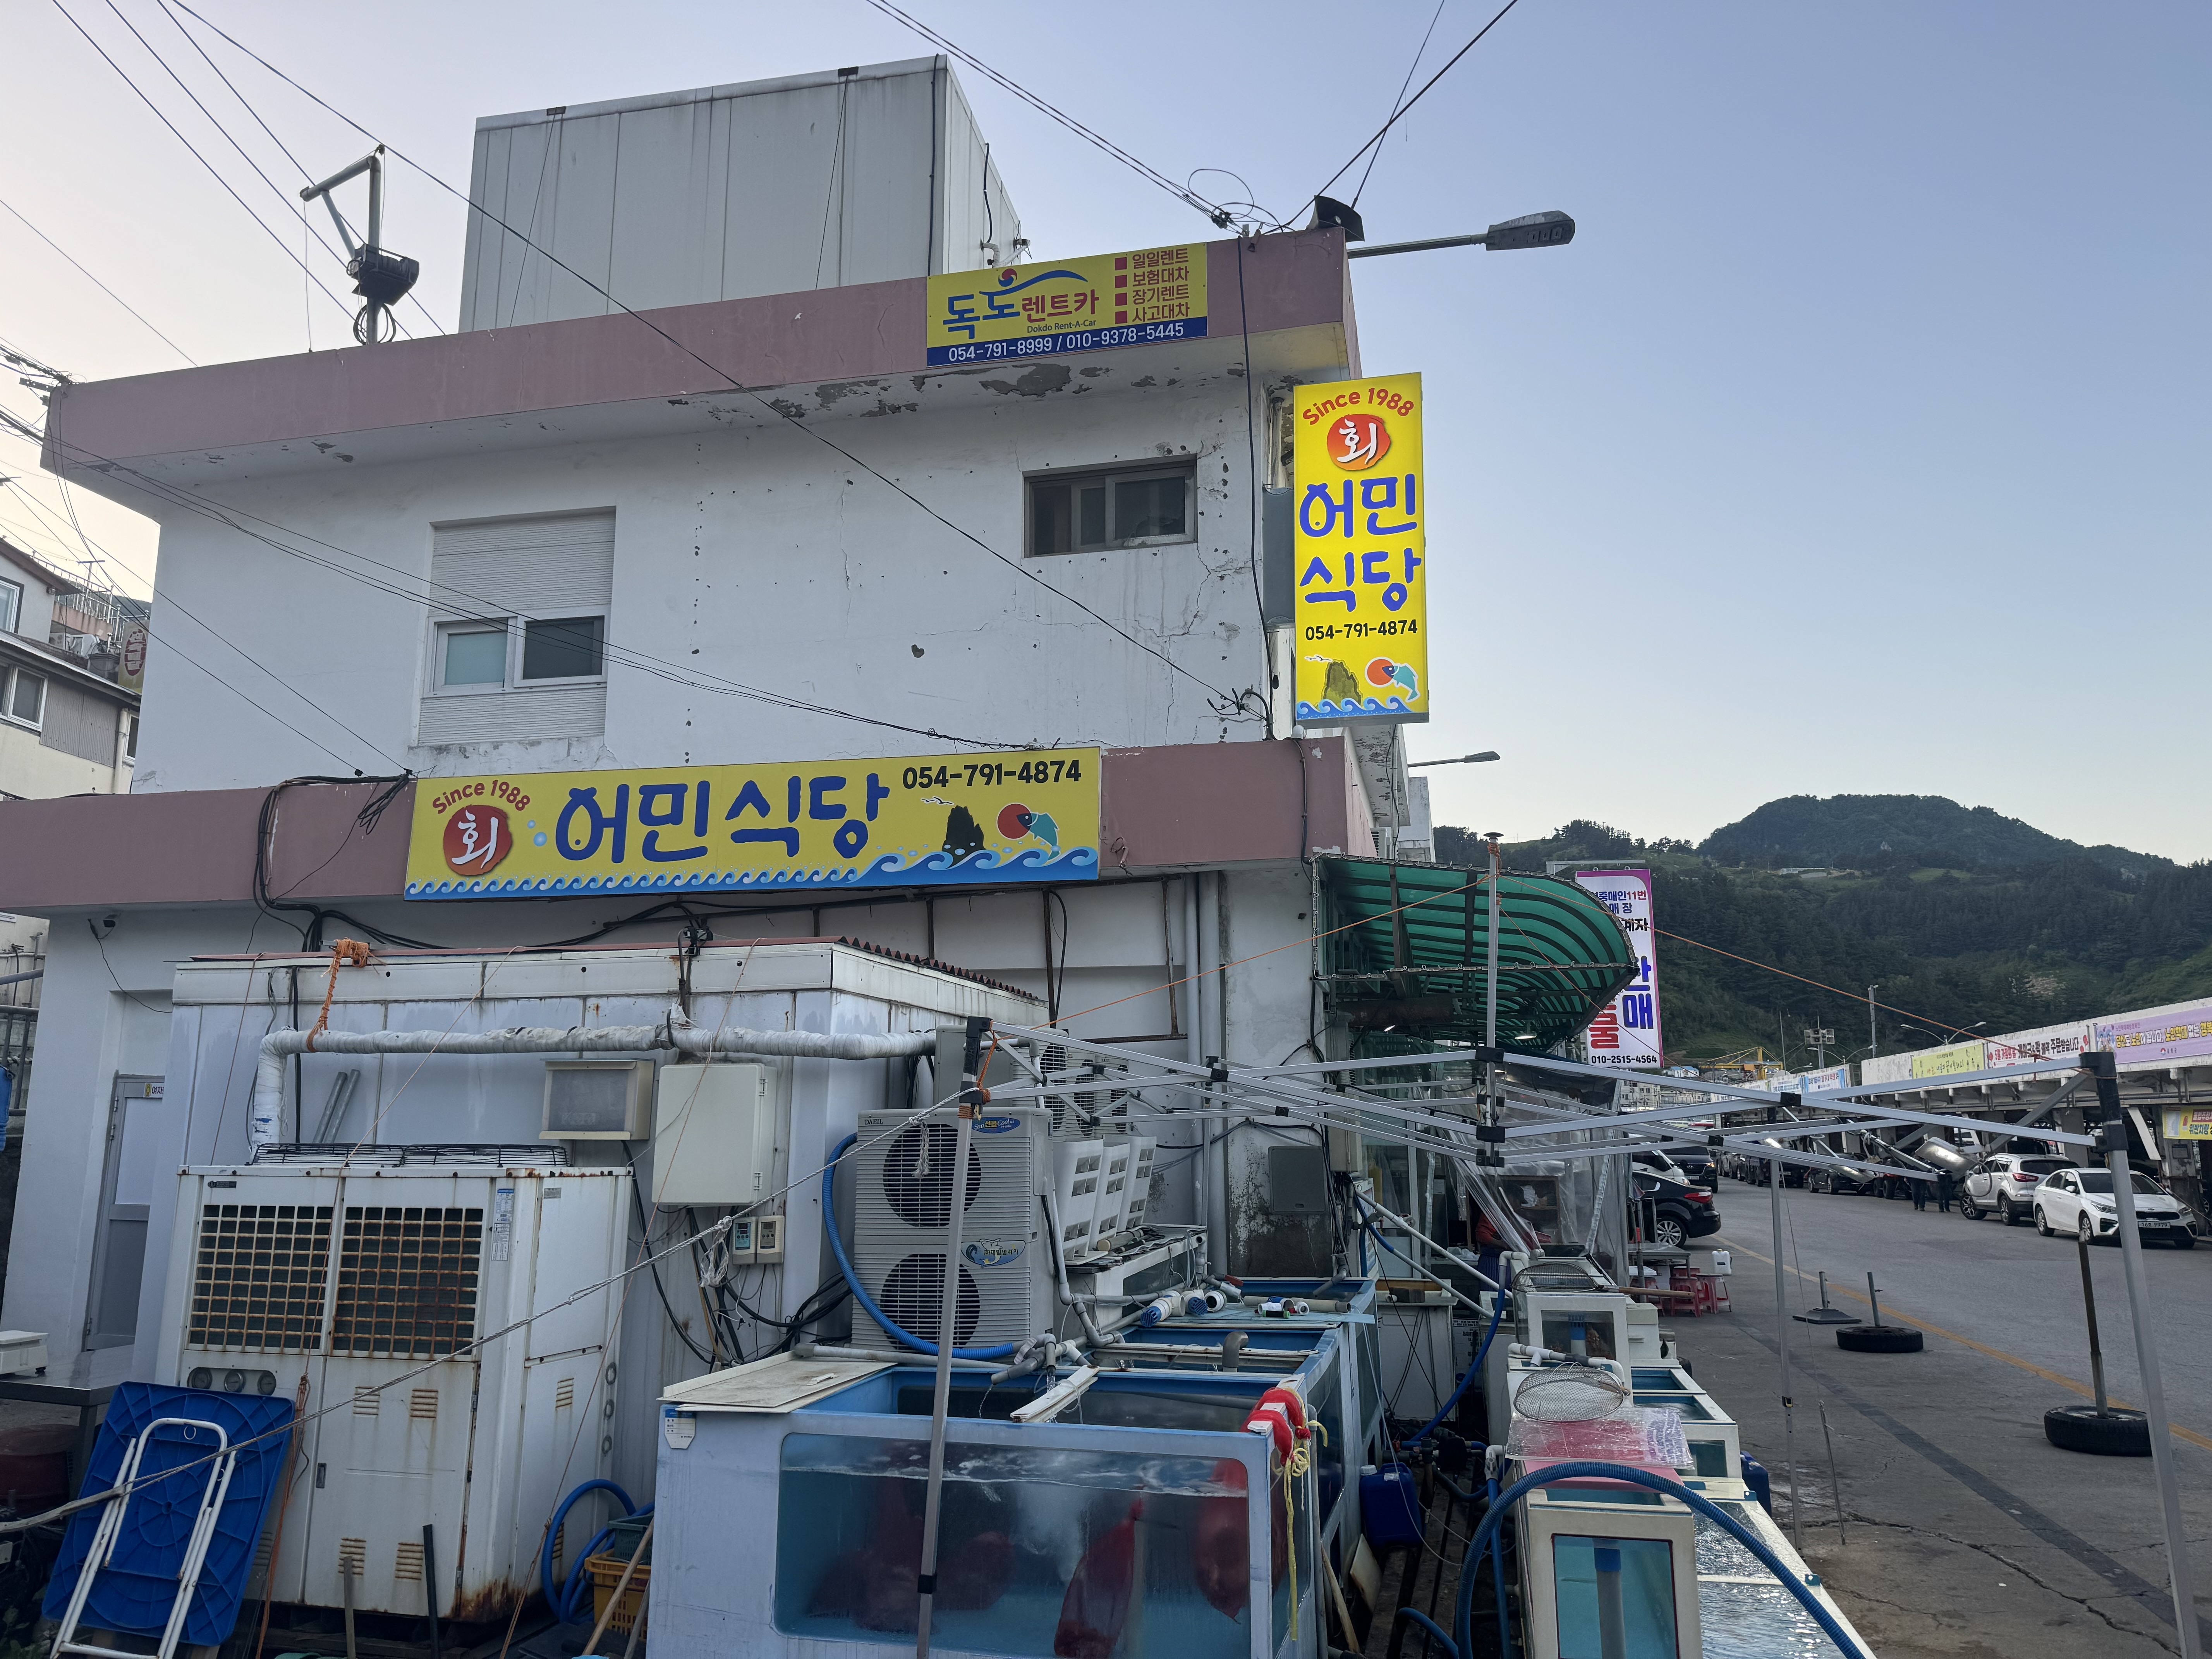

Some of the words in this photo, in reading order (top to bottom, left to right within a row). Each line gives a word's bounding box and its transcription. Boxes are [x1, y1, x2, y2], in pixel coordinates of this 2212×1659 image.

[1132, 248, 1189, 268] 일일렌트
[1133, 267, 1190, 287] 보험대차
[1133, 285, 1189, 304] 장기렌트
[1027, 324, 1053, 333] Dokdo
[1054, 319, 1096, 330] Rent-A-Car
[1132, 303, 1190, 323] 사고대차
[949, 339, 1053, 361] 054-791-8999
[1066, 322, 1184, 349] 010-9378-5445
[1303, 391, 1361, 425] Since
[1368, 388, 1414, 417] 1988
[1337, 420, 1378, 464] 회
[1300, 473, 1417, 538] 어민
[1300, 547, 1422, 612] 식당
[1305, 620, 1418, 641] 054-791-4874
[902, 759, 1081, 789] 054-791-4874
[433, 783, 485, 814] Since
[491, 780, 530, 811] 1988
[452, 810, 499, 868] 회
[1591, 1055, 1657, 1064] 010-2515-4564
